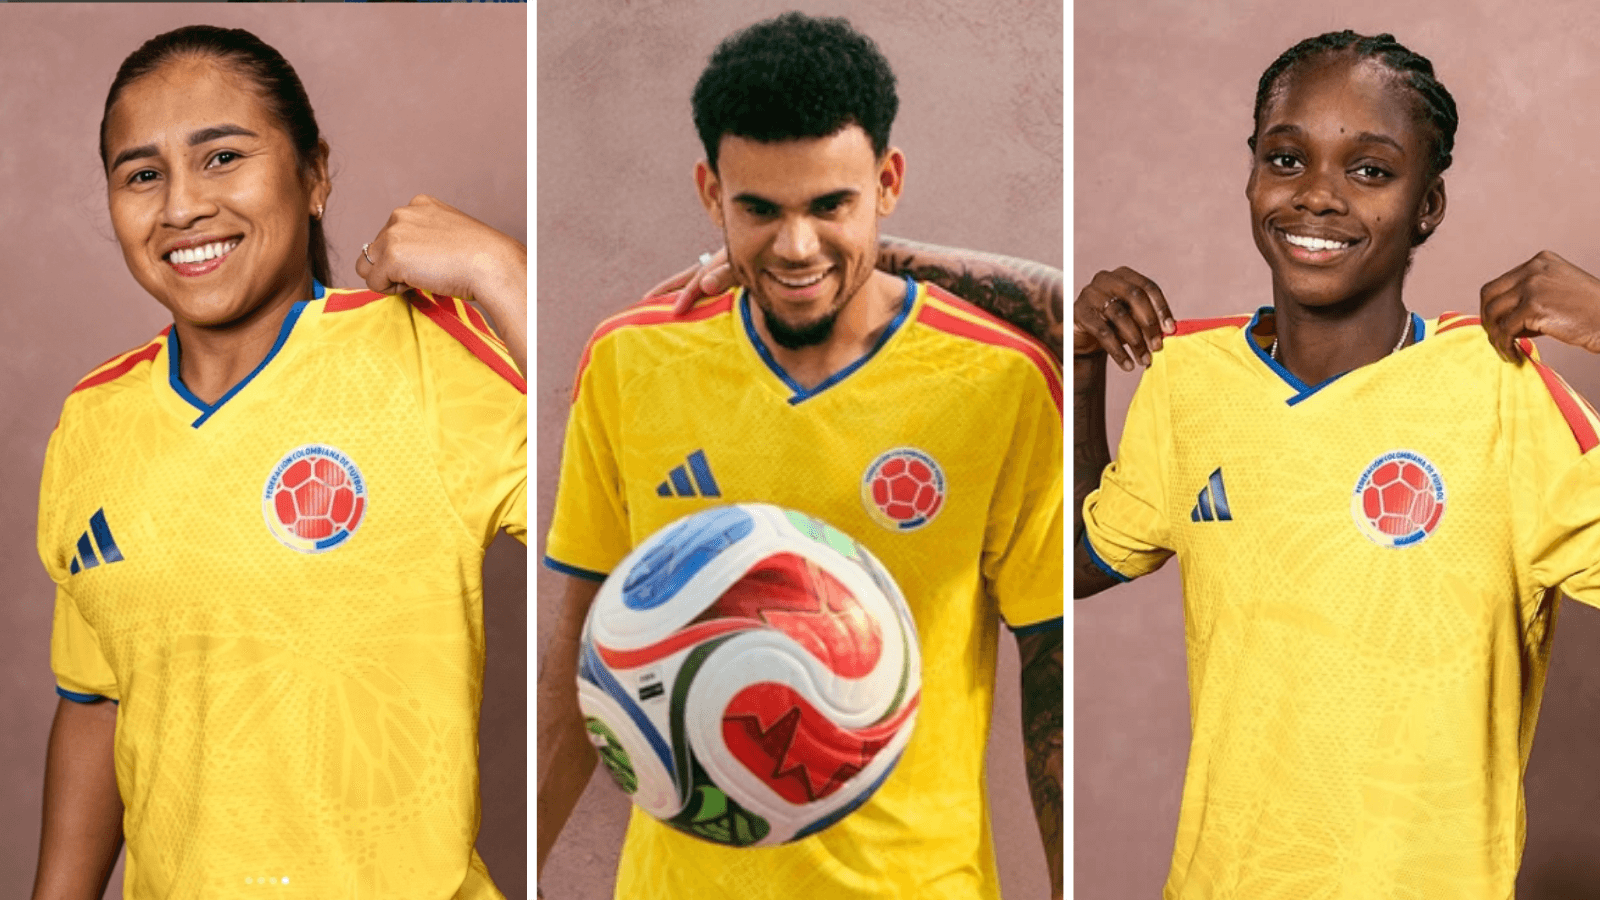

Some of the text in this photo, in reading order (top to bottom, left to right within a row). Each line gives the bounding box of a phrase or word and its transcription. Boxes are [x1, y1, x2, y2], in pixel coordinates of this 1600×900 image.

[292, 447, 340, 460] COLOMBIANA
[339, 456, 350, 467] DE
[1383, 452, 1426, 467] COLOMBIANA
[1425, 464, 1434, 474] DE
